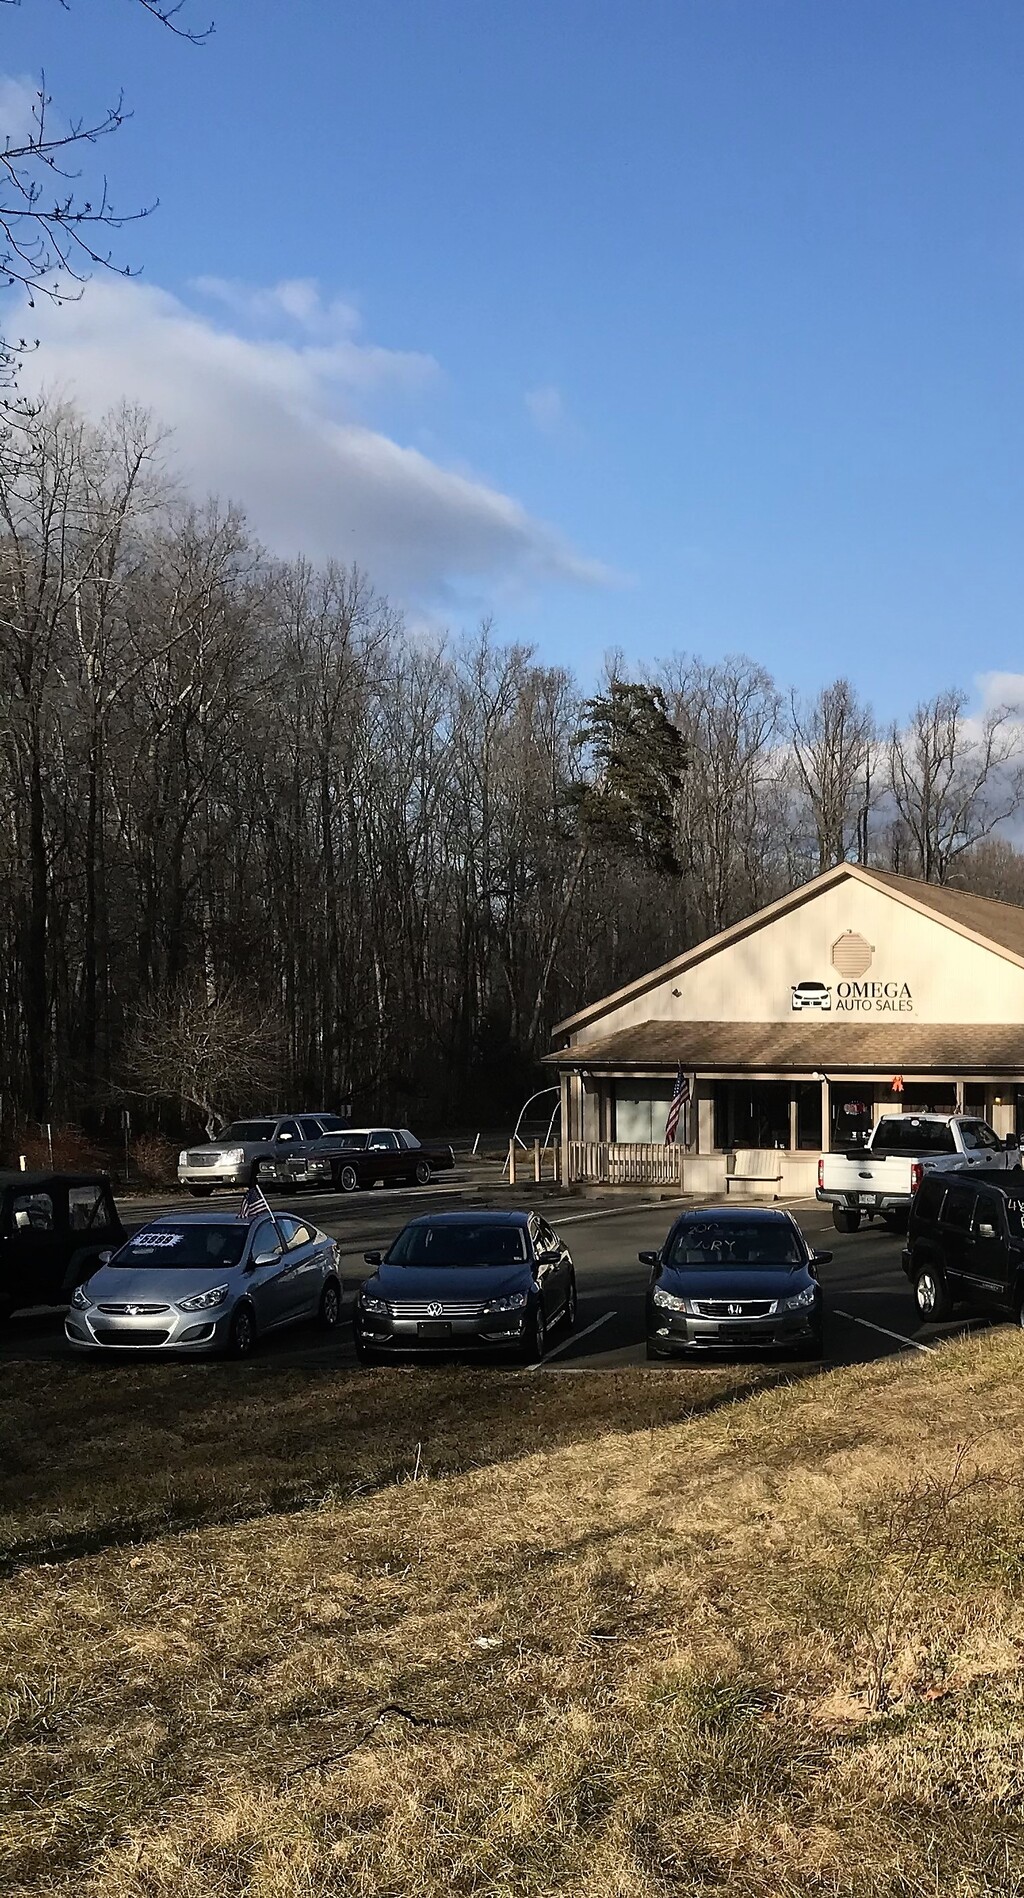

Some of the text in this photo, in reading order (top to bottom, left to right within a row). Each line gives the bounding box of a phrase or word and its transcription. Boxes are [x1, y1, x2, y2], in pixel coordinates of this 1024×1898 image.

[836, 982, 912, 998] OMEGA
[836, 999, 913, 1011] AUTO SALES
